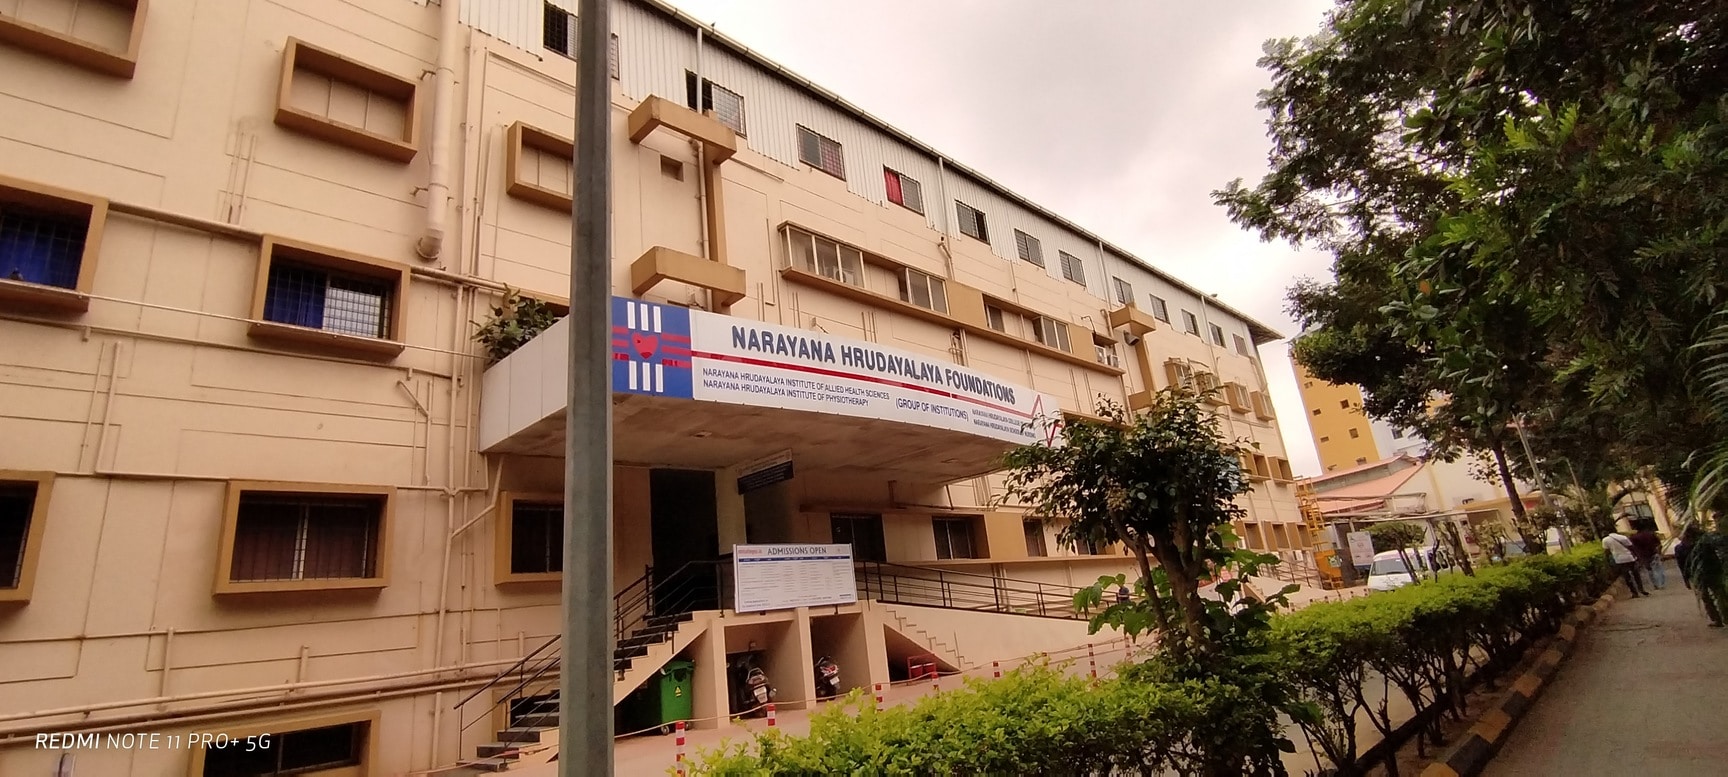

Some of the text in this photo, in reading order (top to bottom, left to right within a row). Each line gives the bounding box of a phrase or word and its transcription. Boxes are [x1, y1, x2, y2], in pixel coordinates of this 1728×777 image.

[731, 325, 1016, 405] NARAYANA HRUDAYALAYA FOUNDATIONS
[702, 367, 890, 400] NARAYANA HRUDAYALAYA INSTITUTE OF ALLIED HEALTH SCIENCES
[703, 379, 869, 407] NARAYANA HRUDAYALAYA INSTITUTE OF PHYSIOTHERAPY
[895, 398, 969, 422] (GROUP OF INSTITUTIONS)
[767, 547, 809, 555] ADMISSIONS
[809, 547, 827, 555] OPEN
